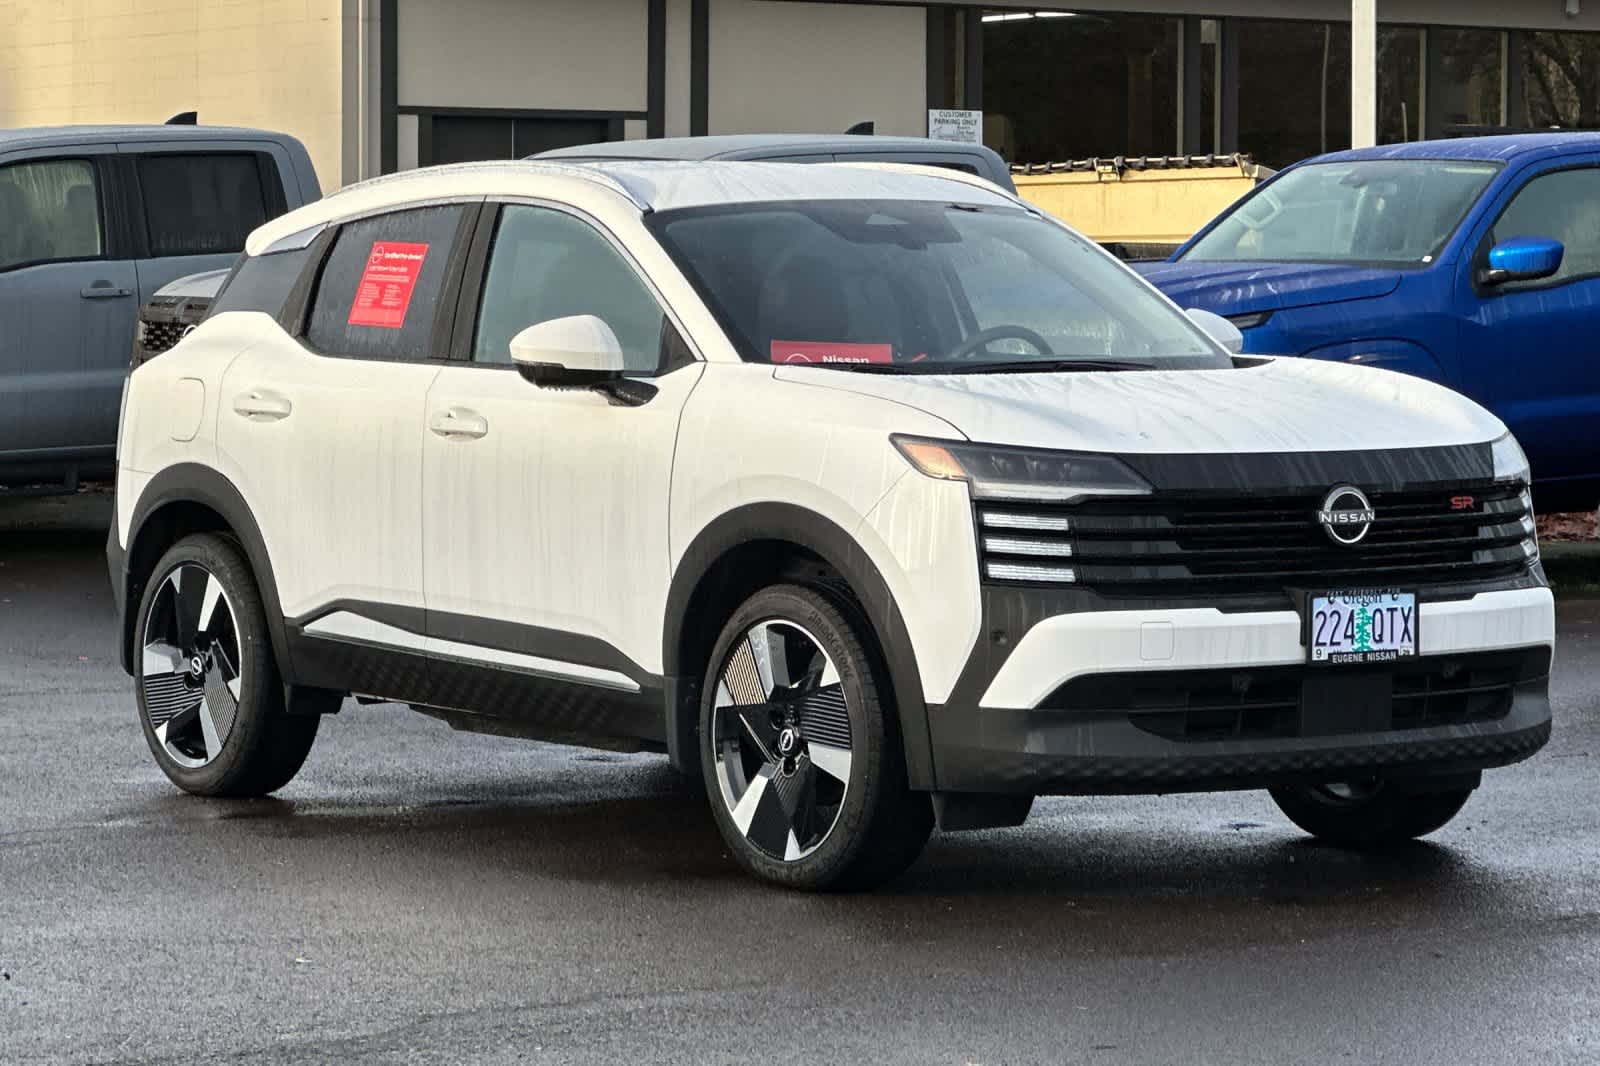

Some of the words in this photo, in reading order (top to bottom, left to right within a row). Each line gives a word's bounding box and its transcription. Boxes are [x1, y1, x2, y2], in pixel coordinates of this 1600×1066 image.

[1450, 496, 1474, 509] SR
[1320, 511, 1376, 523] NISSAN
[1315, 609, 1355, 647] 224
[1372, 606, 1412, 644] QTX
[1315, 649, 1322, 659] 9
[1332, 653, 1363, 664] EUGENE
[1366, 651, 1396, 662] NISSAN
